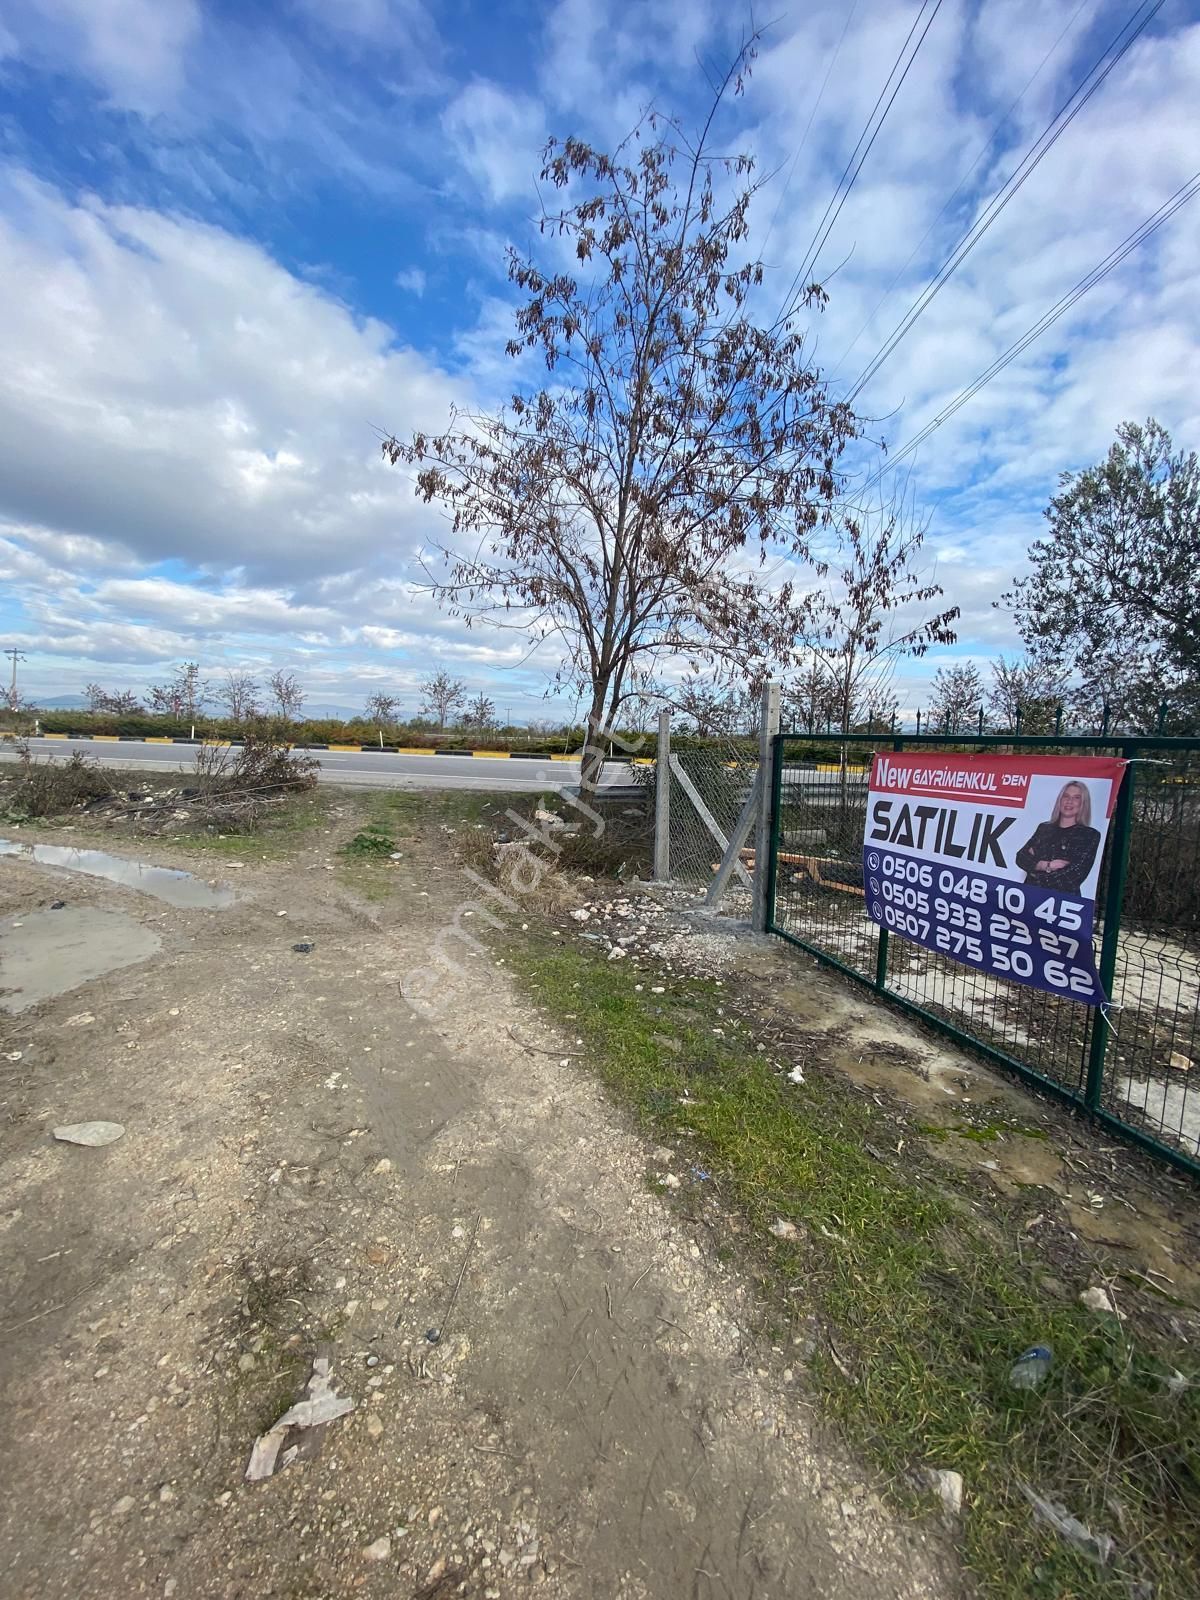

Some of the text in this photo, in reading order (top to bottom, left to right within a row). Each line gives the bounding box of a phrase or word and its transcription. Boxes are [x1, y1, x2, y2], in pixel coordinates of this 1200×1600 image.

[875, 758, 912, 789] New
[912, 766, 998, 791] GAYRİMENKUL
[869, 800, 1017, 869] SATILIK
[882, 855, 1085, 931] 0506 048 10 45
[882, 880, 1079, 959] 0505 933 23 27
[884, 905, 1095, 991] 0507 275 50 62
